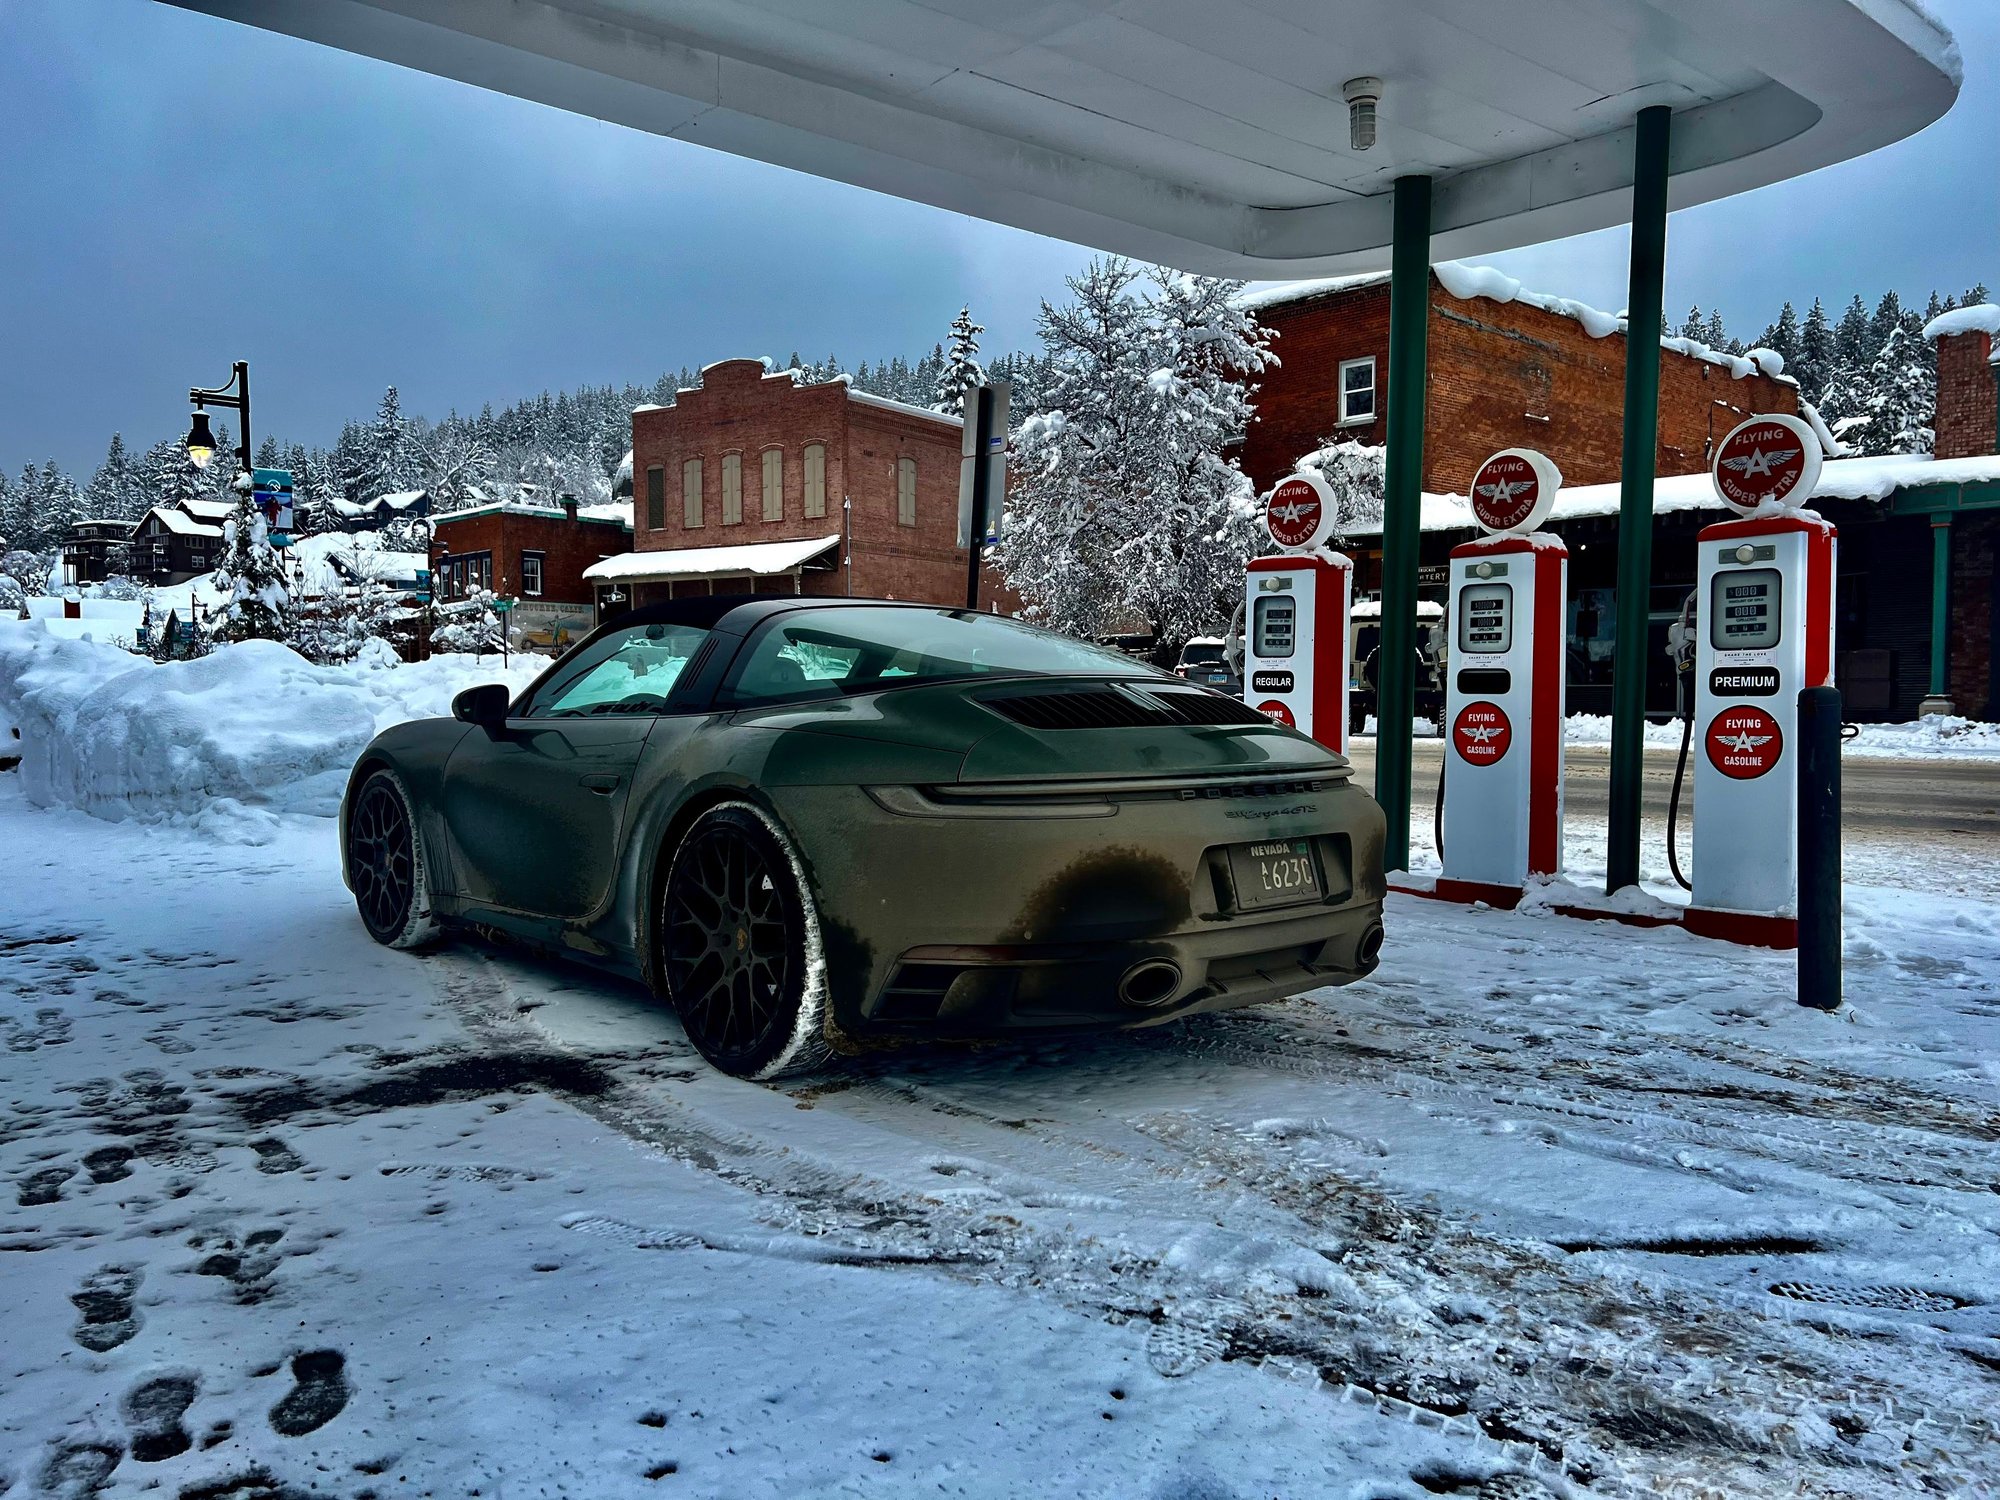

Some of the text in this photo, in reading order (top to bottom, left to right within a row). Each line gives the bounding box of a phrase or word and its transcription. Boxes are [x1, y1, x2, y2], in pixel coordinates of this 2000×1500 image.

[1735, 428, 1784, 446] FLYING
[1486, 462, 1524, 474] FLYING
[1278, 486, 1309, 497] FLYING
[1723, 478, 1757, 504] SUPER
[1476, 499, 1533, 526] SUPER EXTRA
[1270, 518, 1318, 544] SUPER EXTRA
[1255, 677, 1291, 687] REGULAR
[1715, 676, 1775, 688] PREMIUM
[1468, 713, 1495, 722] FLYING
[1726, 718, 1761, 729] FLYING
[1467, 745, 1496, 755] GASOLINE
[1724, 755, 1762, 766] GASOLINE
[1180, 781, 1322, 800] PORSCHE
[1250, 843, 1290, 857] NEVADA
